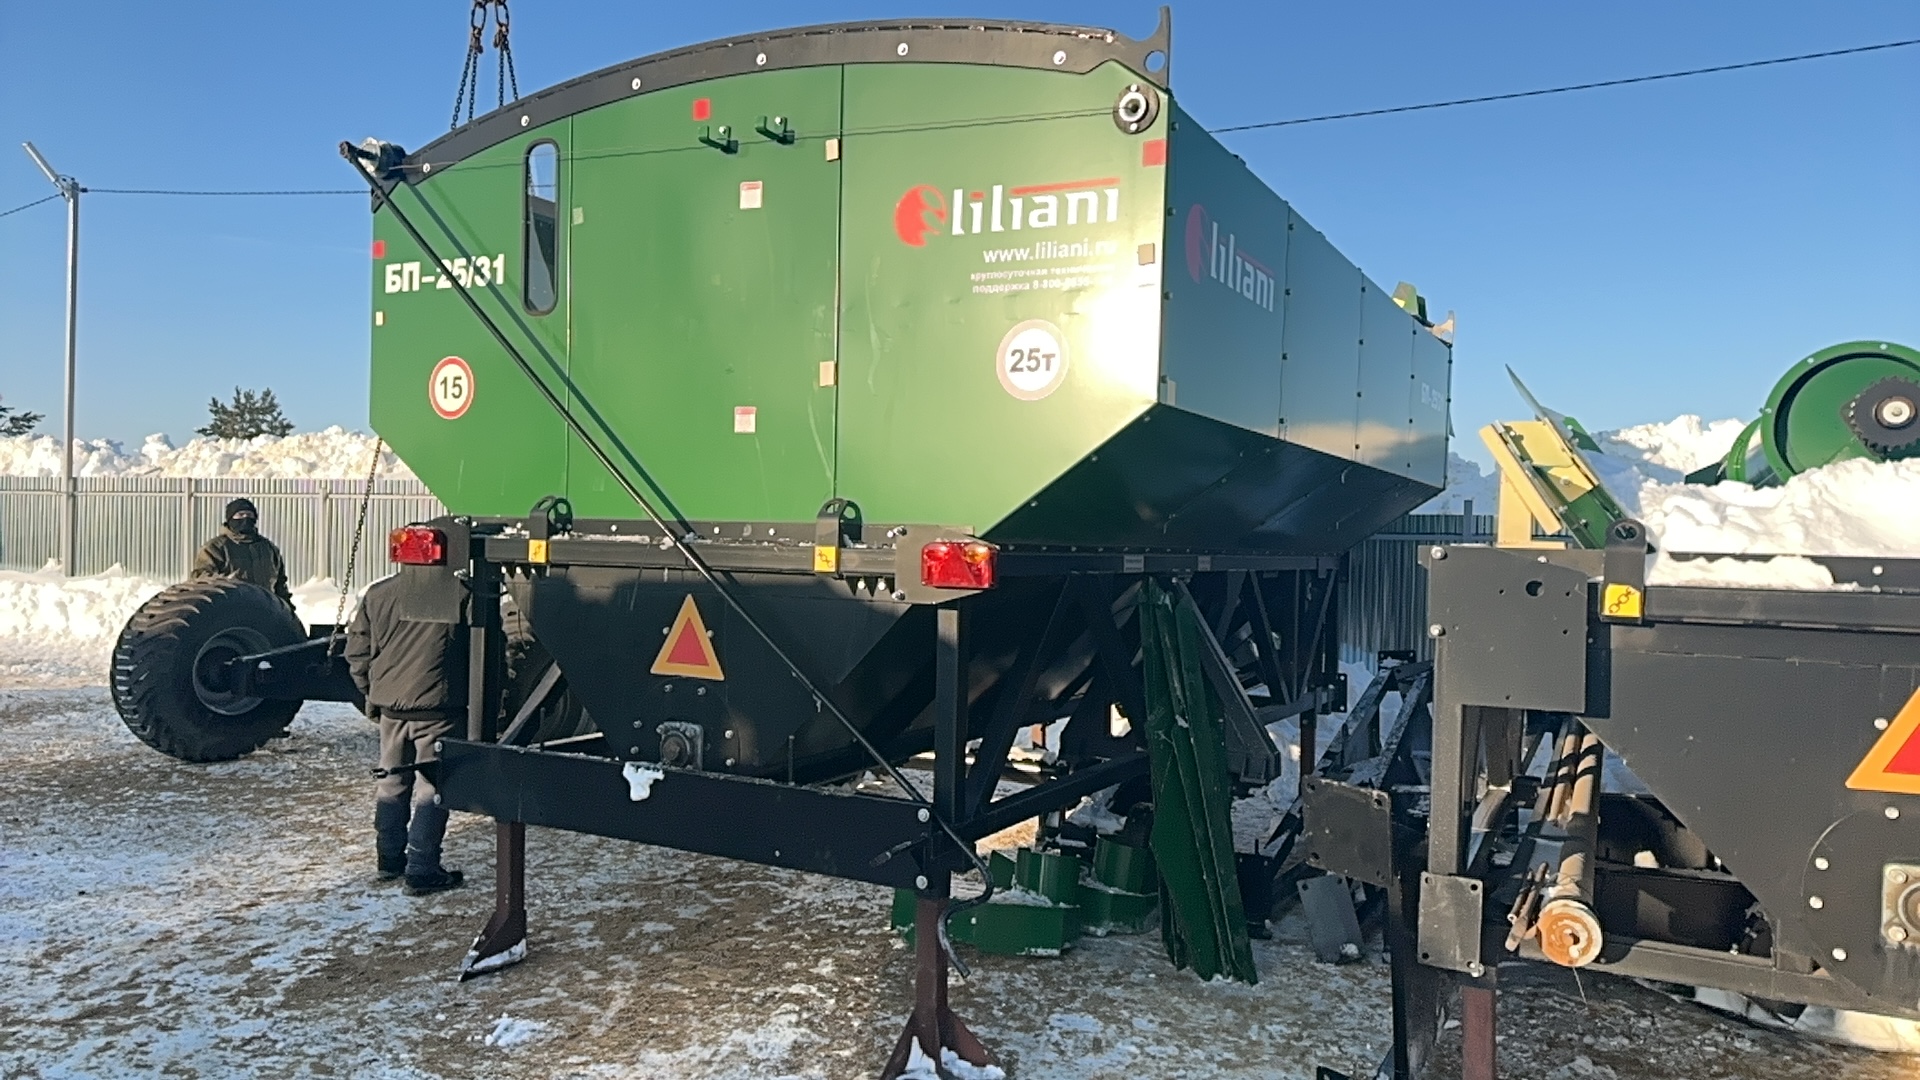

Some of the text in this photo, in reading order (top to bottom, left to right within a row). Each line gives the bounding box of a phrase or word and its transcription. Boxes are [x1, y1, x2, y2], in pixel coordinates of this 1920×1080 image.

[952, 180, 1120, 235] liliani
[385, 254, 505, 293] БП-25/31
[1210, 221, 1275, 312] liliani
[972, 281, 1030, 294] поддержка
[440, 375, 463, 399] 15
